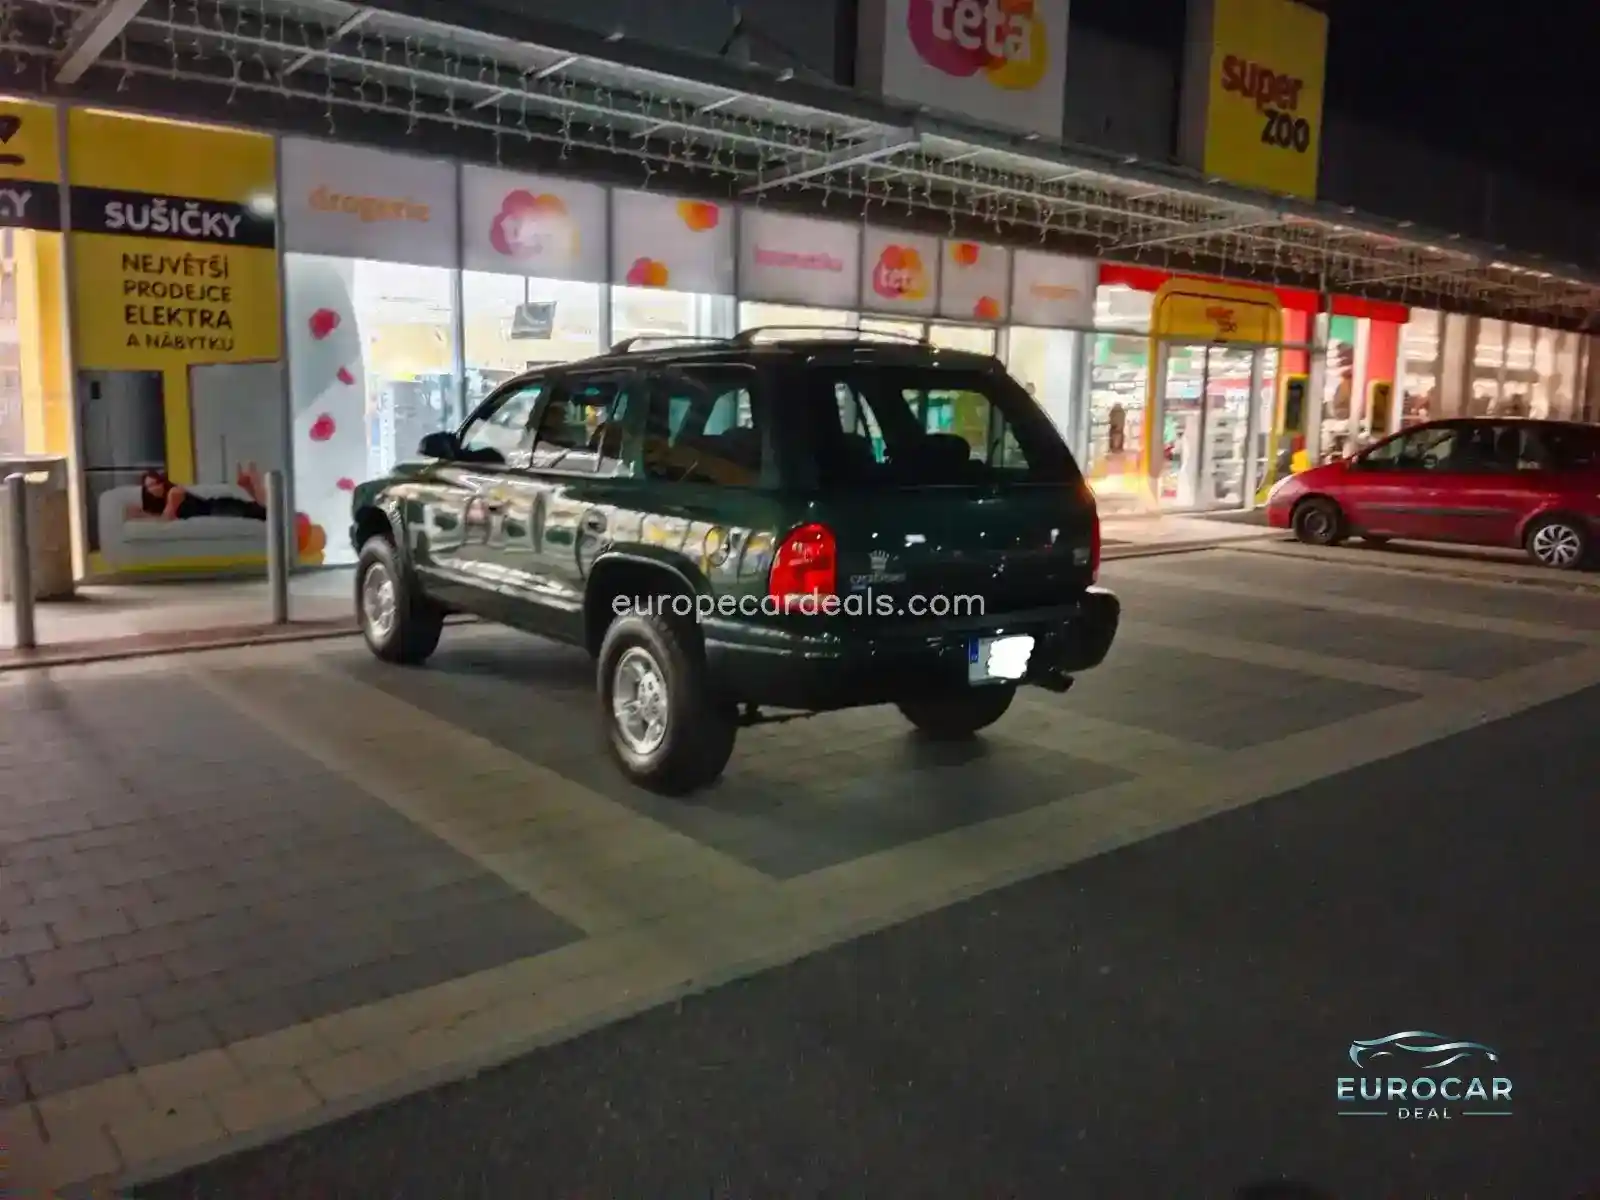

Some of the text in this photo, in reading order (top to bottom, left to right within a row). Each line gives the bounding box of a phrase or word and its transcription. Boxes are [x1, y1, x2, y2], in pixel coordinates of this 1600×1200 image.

[931, 0, 1032, 62] teta
[1221, 54, 1303, 113] super
[105, 198, 242, 238] SUŠIČKY
[121, 252, 229, 279] NEJVĚTŠÍ
[123, 279, 233, 303] PRODEJCE
[124, 304, 233, 330] ELEKTRA
[126, 333, 235, 352] A NÁBYTKU
